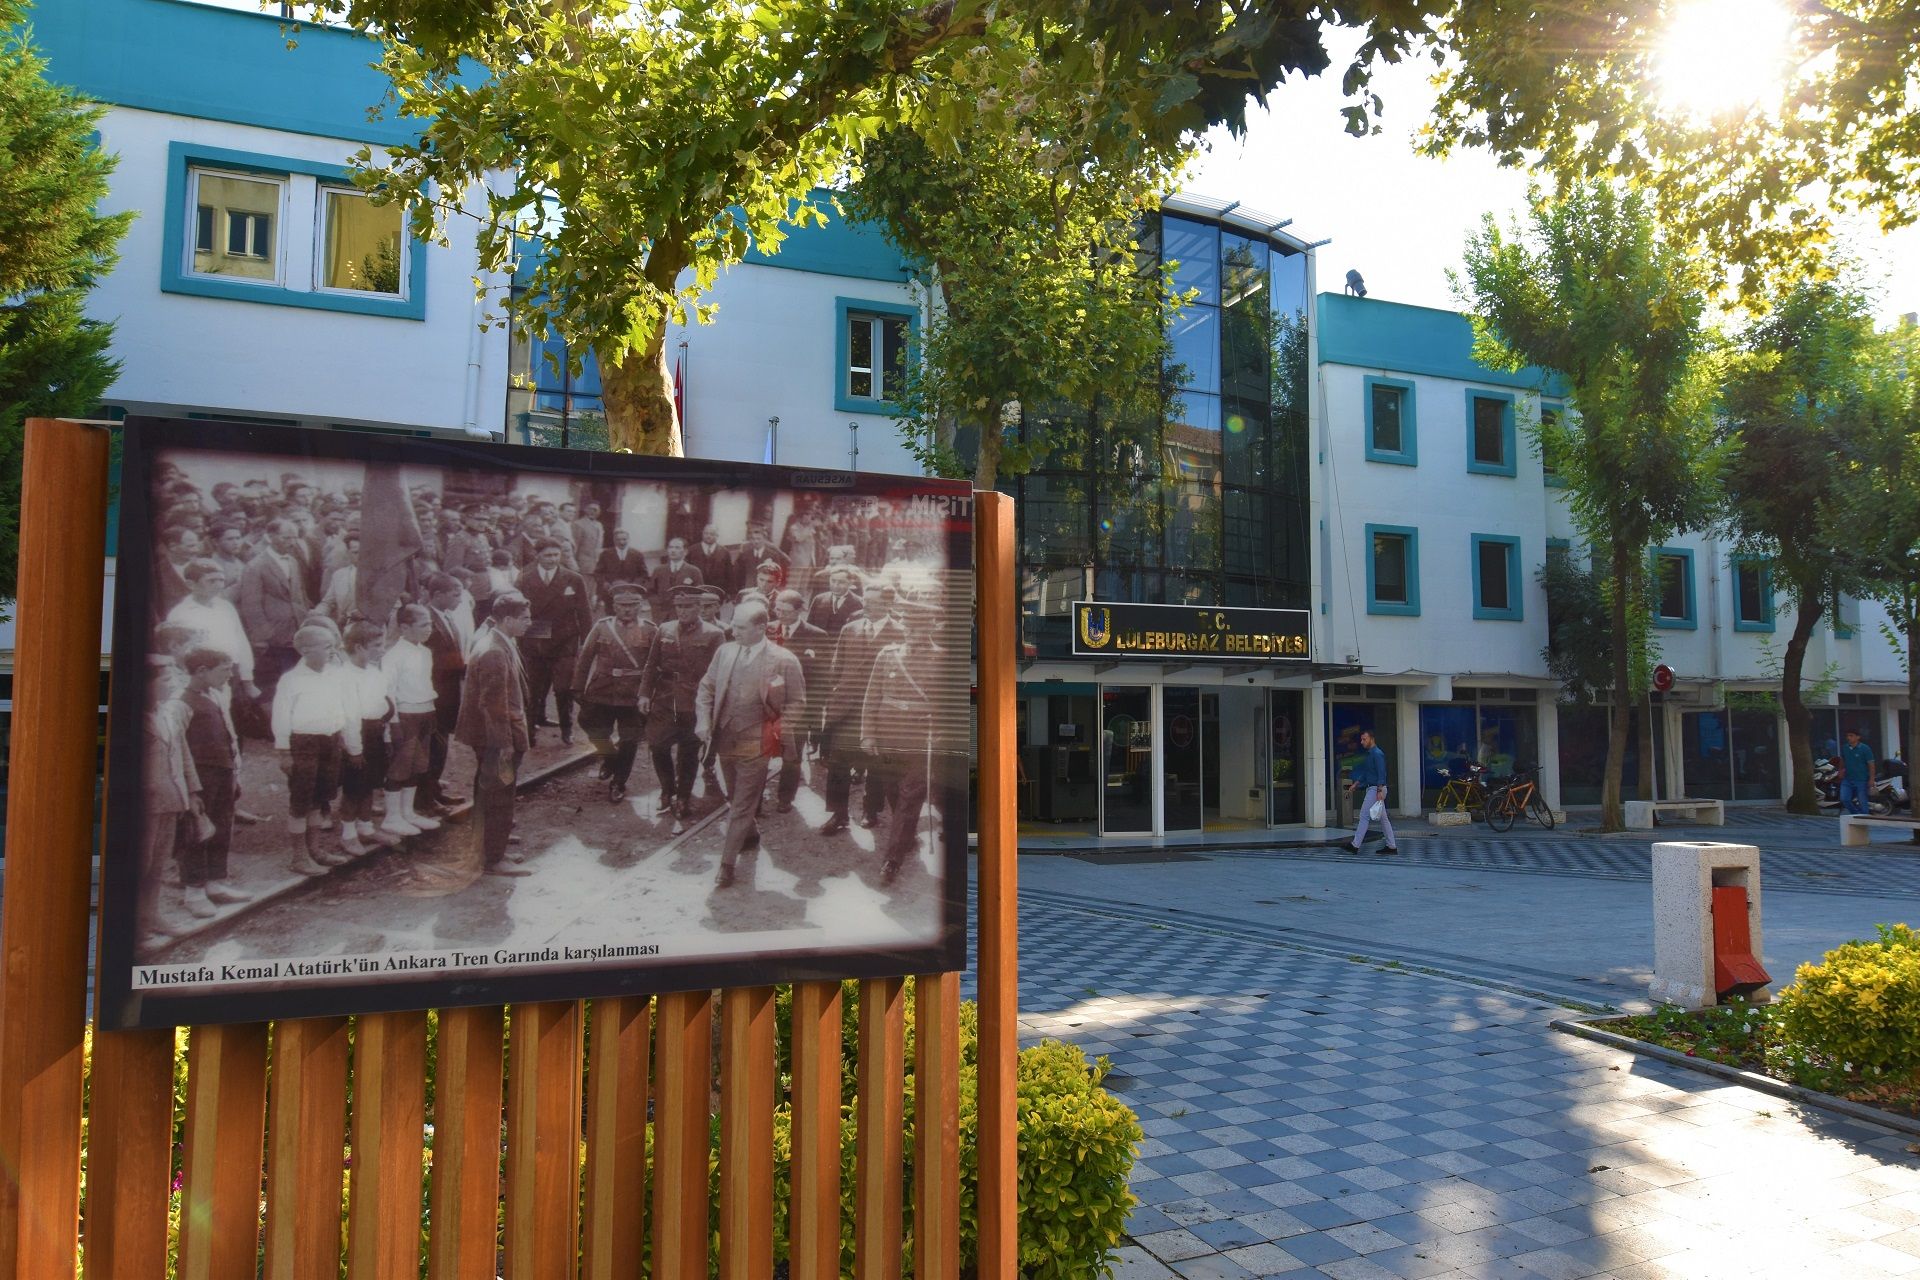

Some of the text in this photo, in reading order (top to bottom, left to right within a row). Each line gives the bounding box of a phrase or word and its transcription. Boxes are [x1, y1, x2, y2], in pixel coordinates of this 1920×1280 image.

[139, 944, 660, 986] Mustafa Kemal Atatürk'ün Ankara Tren Garında karşılanması
